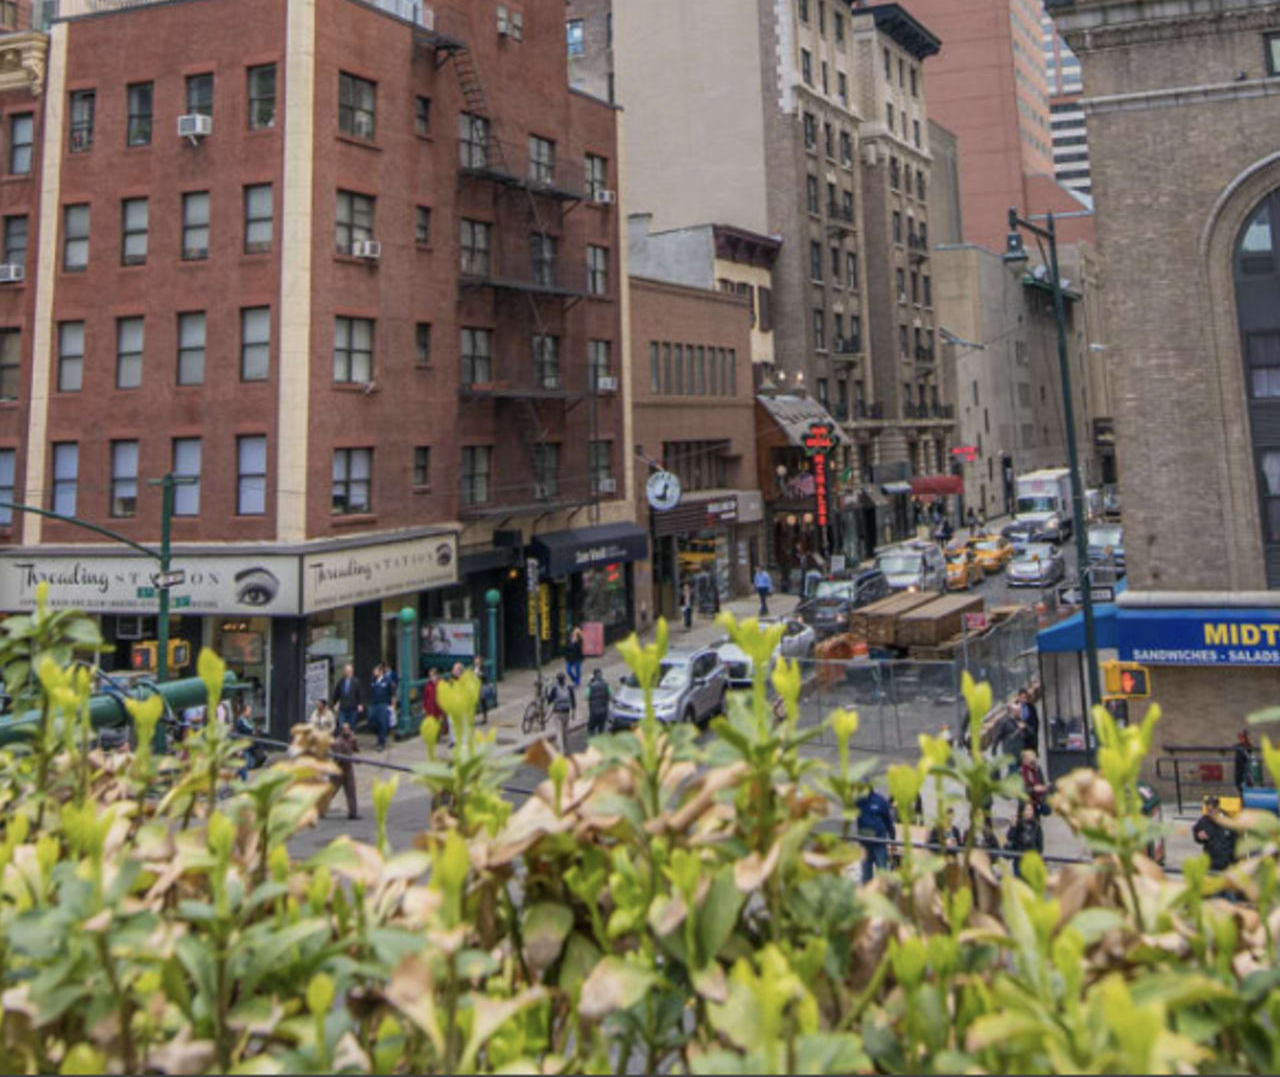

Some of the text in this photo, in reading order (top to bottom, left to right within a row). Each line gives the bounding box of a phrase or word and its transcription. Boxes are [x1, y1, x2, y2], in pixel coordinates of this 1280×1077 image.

[14, 561, 109, 594] Threading
[115, 572, 219, 585] STON
[309, 557, 373, 592] Threading
[1132, 649, 1217, 662] SANDWICHES
[1228, 650, 1280, 662] SALADS
